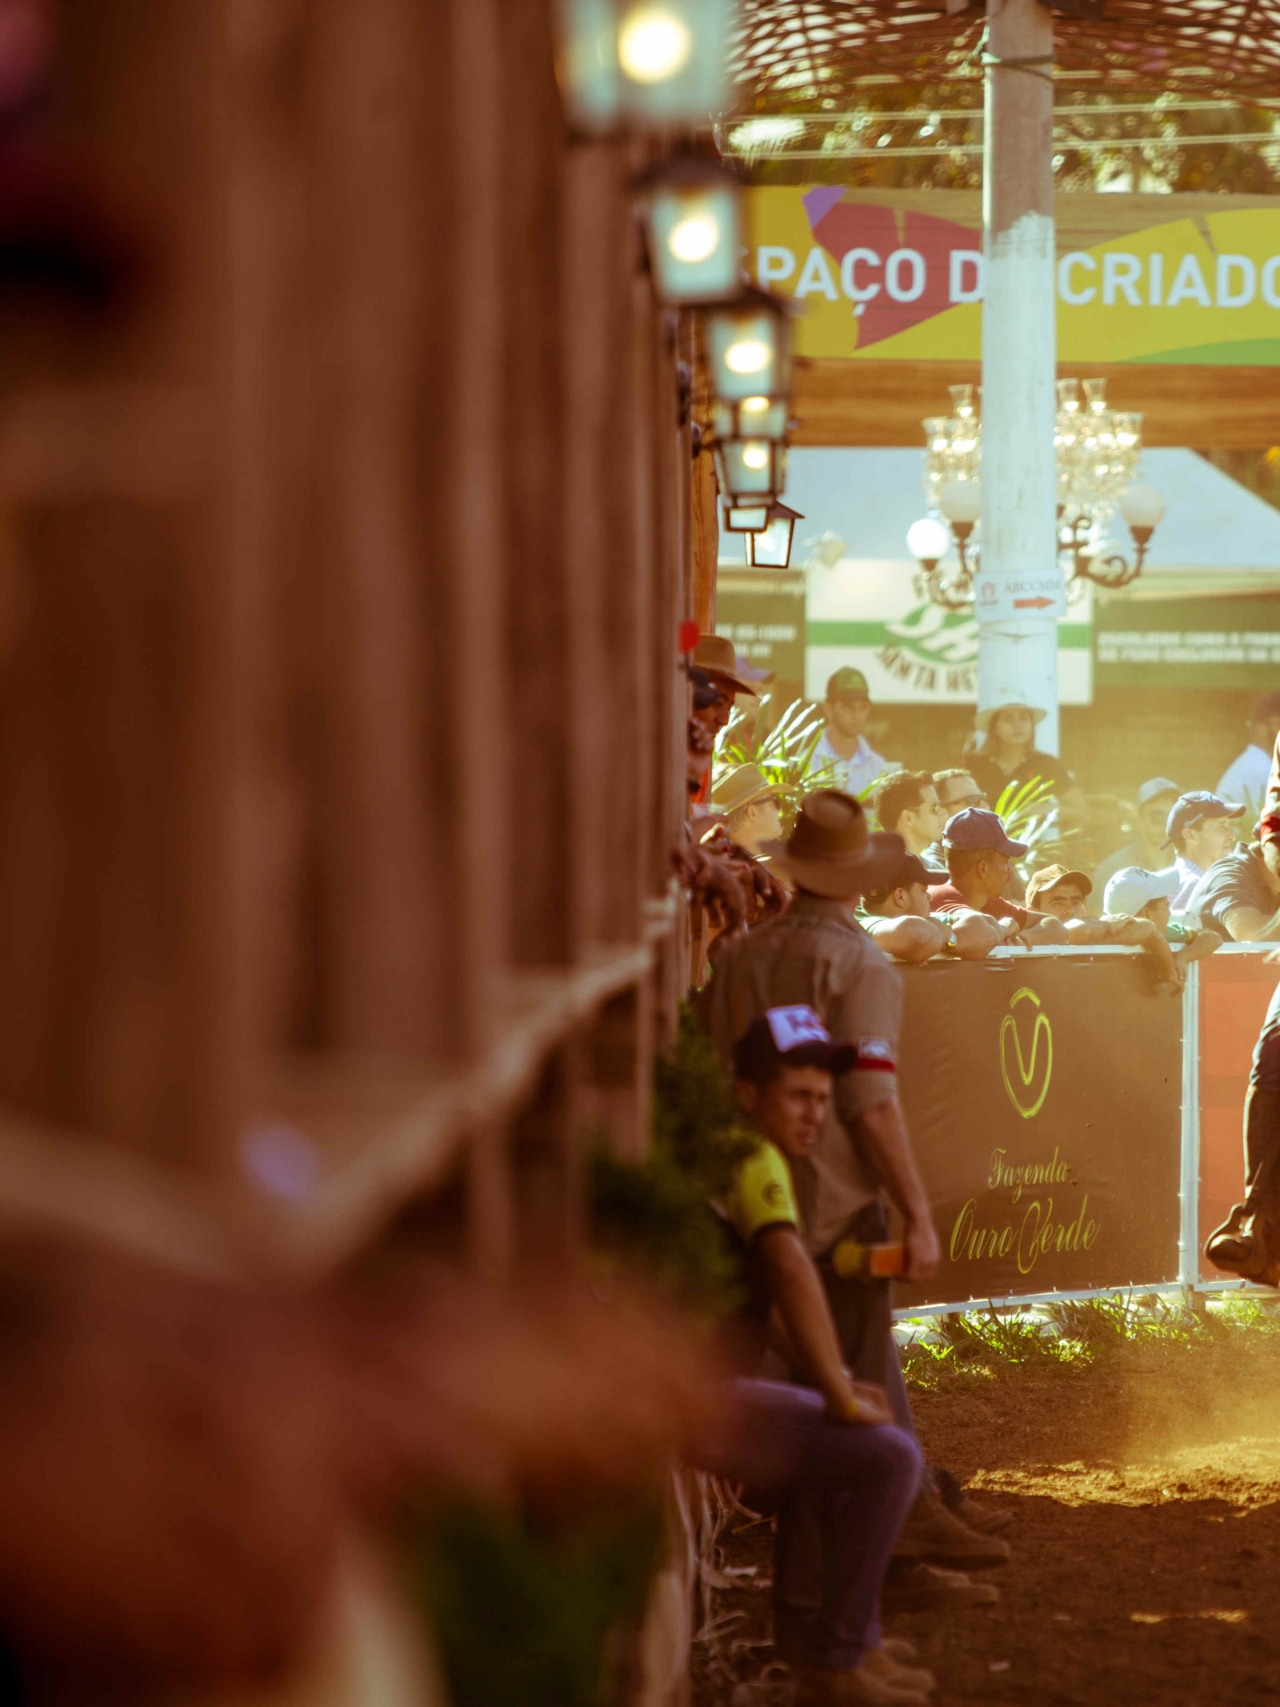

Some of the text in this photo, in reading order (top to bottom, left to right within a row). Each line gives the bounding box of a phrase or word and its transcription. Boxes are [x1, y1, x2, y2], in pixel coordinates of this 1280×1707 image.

[740, 245, 926, 317] PAÇO
[949, 249, 984, 304] D
[1003, 579, 1061, 594] ABCCMM
[987, 1145, 1069, 1204] Fazenda
[950, 1193, 1101, 1274] Ouro Verde
